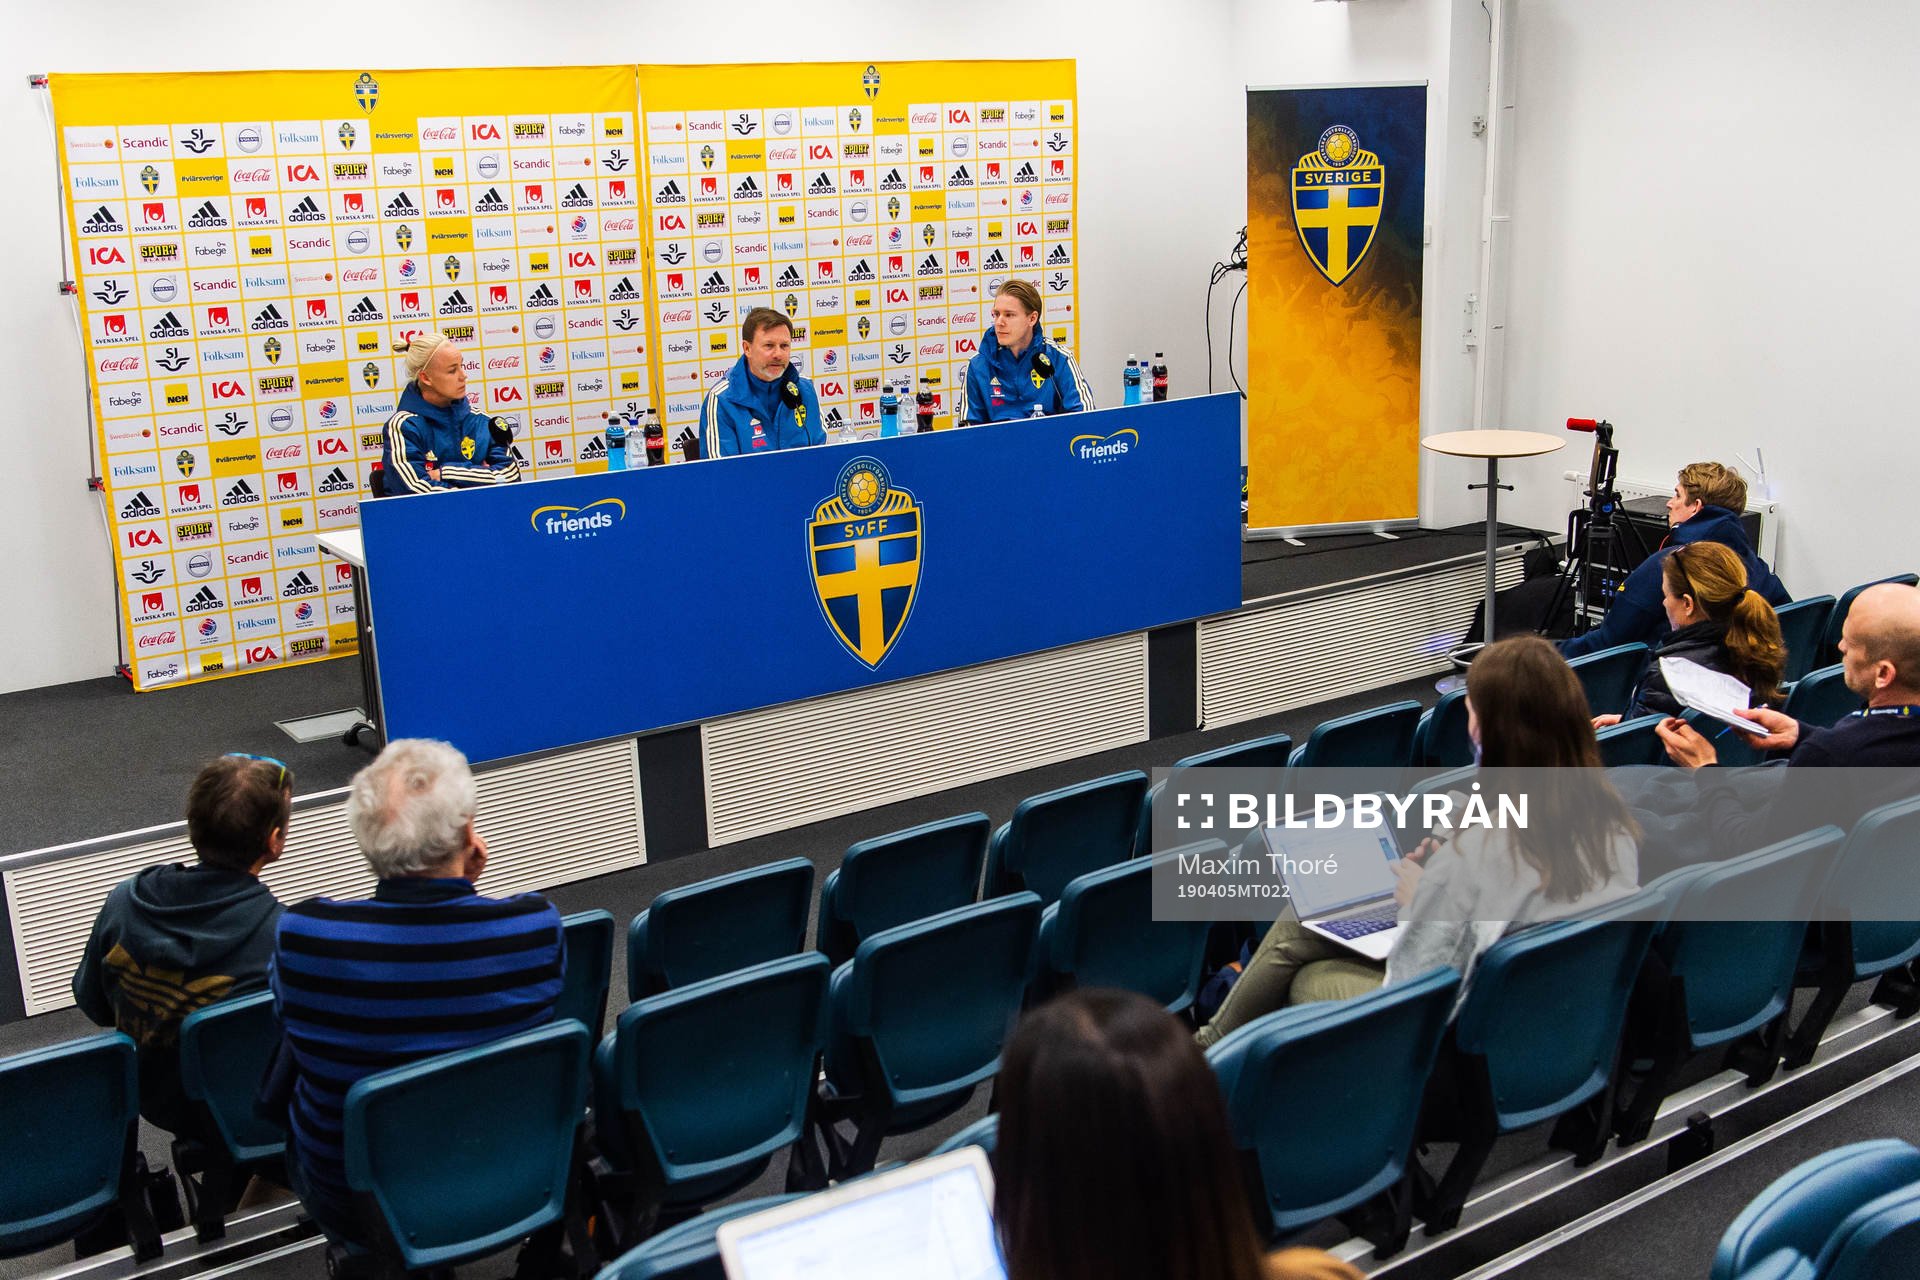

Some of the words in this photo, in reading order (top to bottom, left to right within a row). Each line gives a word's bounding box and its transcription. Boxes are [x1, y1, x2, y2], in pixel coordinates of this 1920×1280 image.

[949, 110, 970, 124] ICA
[981, 109, 1004, 119] SPORT
[514, 123, 544, 135] SPORT
[559, 127, 585, 136] Fabege
[689, 122, 722, 130] Scandic
[191, 129, 203, 139] SJ
[472, 124, 500, 140] ICA
[123, 138, 168, 148] Scandic
[280, 134, 318, 143] Folksam
[809, 145, 832, 159] ICA
[514, 159, 550, 169] Scandic
[653, 155, 684, 164] Folksam
[288, 165, 319, 182] ICA
[334, 163, 367, 176] SPORT
[384, 166, 412, 176] Fabege
[76, 178, 119, 187] Folksam
[1305, 172, 1371, 184] SVERIGE
[384, 208, 419, 217] adidas
[475, 203, 508, 212] adidas
[188, 217, 227, 227] adidas
[289, 213, 325, 222] adidas
[697, 213, 724, 224] SPORT
[83, 223, 123, 233] adidas
[477, 227, 511, 238] Folksam
[289, 238, 331, 249] Scandic
[735, 244, 767, 253] Scandic
[90, 248, 125, 265] ICA
[141, 245, 177, 258] SPORT
[195, 247, 226, 257] Fabege
[569, 252, 596, 267] ICA
[918, 267, 943, 275] adidas
[104, 280, 116, 291] SJ
[194, 279, 237, 291] Scandic
[246, 278, 285, 287] Folksam
[701, 285, 730, 294] adidas
[919, 286, 943, 295] SPORT
[609, 292, 639, 301] adidas
[887, 289, 909, 302] ICA
[440, 305, 473, 315] adidas
[621, 310, 630, 319] SJ
[252, 320, 288, 330] adidas
[918, 317, 946, 326] Scandic
[150, 328, 189, 339] adidas
[166, 348, 177, 358] SJ
[307, 344, 335, 353] Fabege
[204, 352, 243, 361] Folksam
[260, 377, 293, 390] SPORT
[578, 382, 602, 392] Fabege
[855, 379, 878, 389] SPORT
[212, 381, 245, 398] ICA
[821, 383, 843, 397] ICA
[110, 397, 141, 407] Fabege
[627, 403, 636, 412] SJ
[357, 405, 393, 414] Folksam
[225, 412, 236, 423] SJ
[534, 416, 570, 427] Scandic
[160, 424, 203, 436] Scandic
[318, 438, 348, 455] ICA
[1080, 440, 1128, 459] friends
[114, 465, 156, 476] Folksam
[319, 482, 354, 493] adidas
[223, 494, 259, 506] adidas
[121, 507, 160, 518] adidas
[320, 506, 358, 518] Scandic
[230, 521, 259, 531] Fabege
[546, 512, 612, 534] friends
[177, 523, 212, 537] SPORT
[845, 520, 888, 538] SvFF
[128, 530, 162, 548] ICA
[278, 545, 315, 557] Folksam
[228, 551, 269, 564] Scandic
[142, 561, 154, 571] SJ
[283, 584, 319, 597] adidas
[186, 600, 223, 612] adidas
[237, 617, 276, 630] Folksam
[291, 638, 324, 651] SPORT
[246, 646, 278, 664] ICA
[148, 669, 178, 679] Fabege
